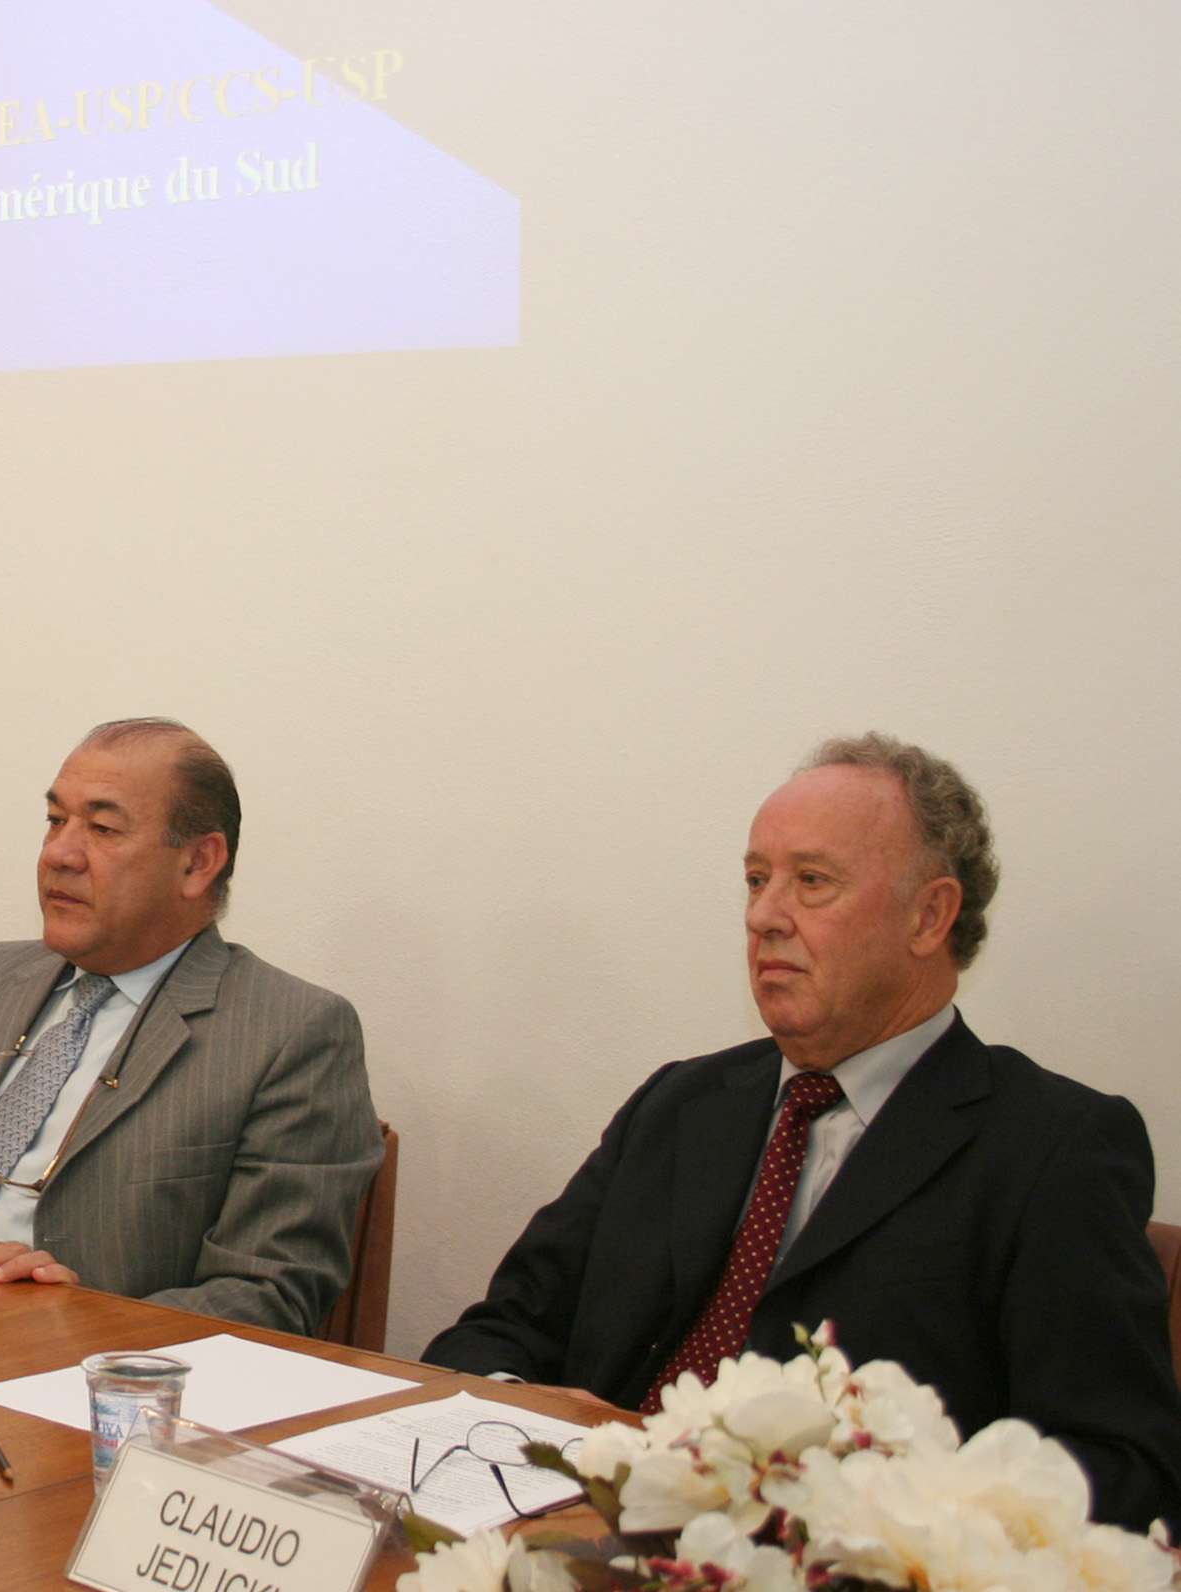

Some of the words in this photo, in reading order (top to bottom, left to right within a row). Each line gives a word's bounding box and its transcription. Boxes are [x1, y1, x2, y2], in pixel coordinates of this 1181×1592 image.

[165, 156, 222, 204] du
[234, 141, 321, 197] Sud
[159, 1490, 300, 1567] CLAUDIO
